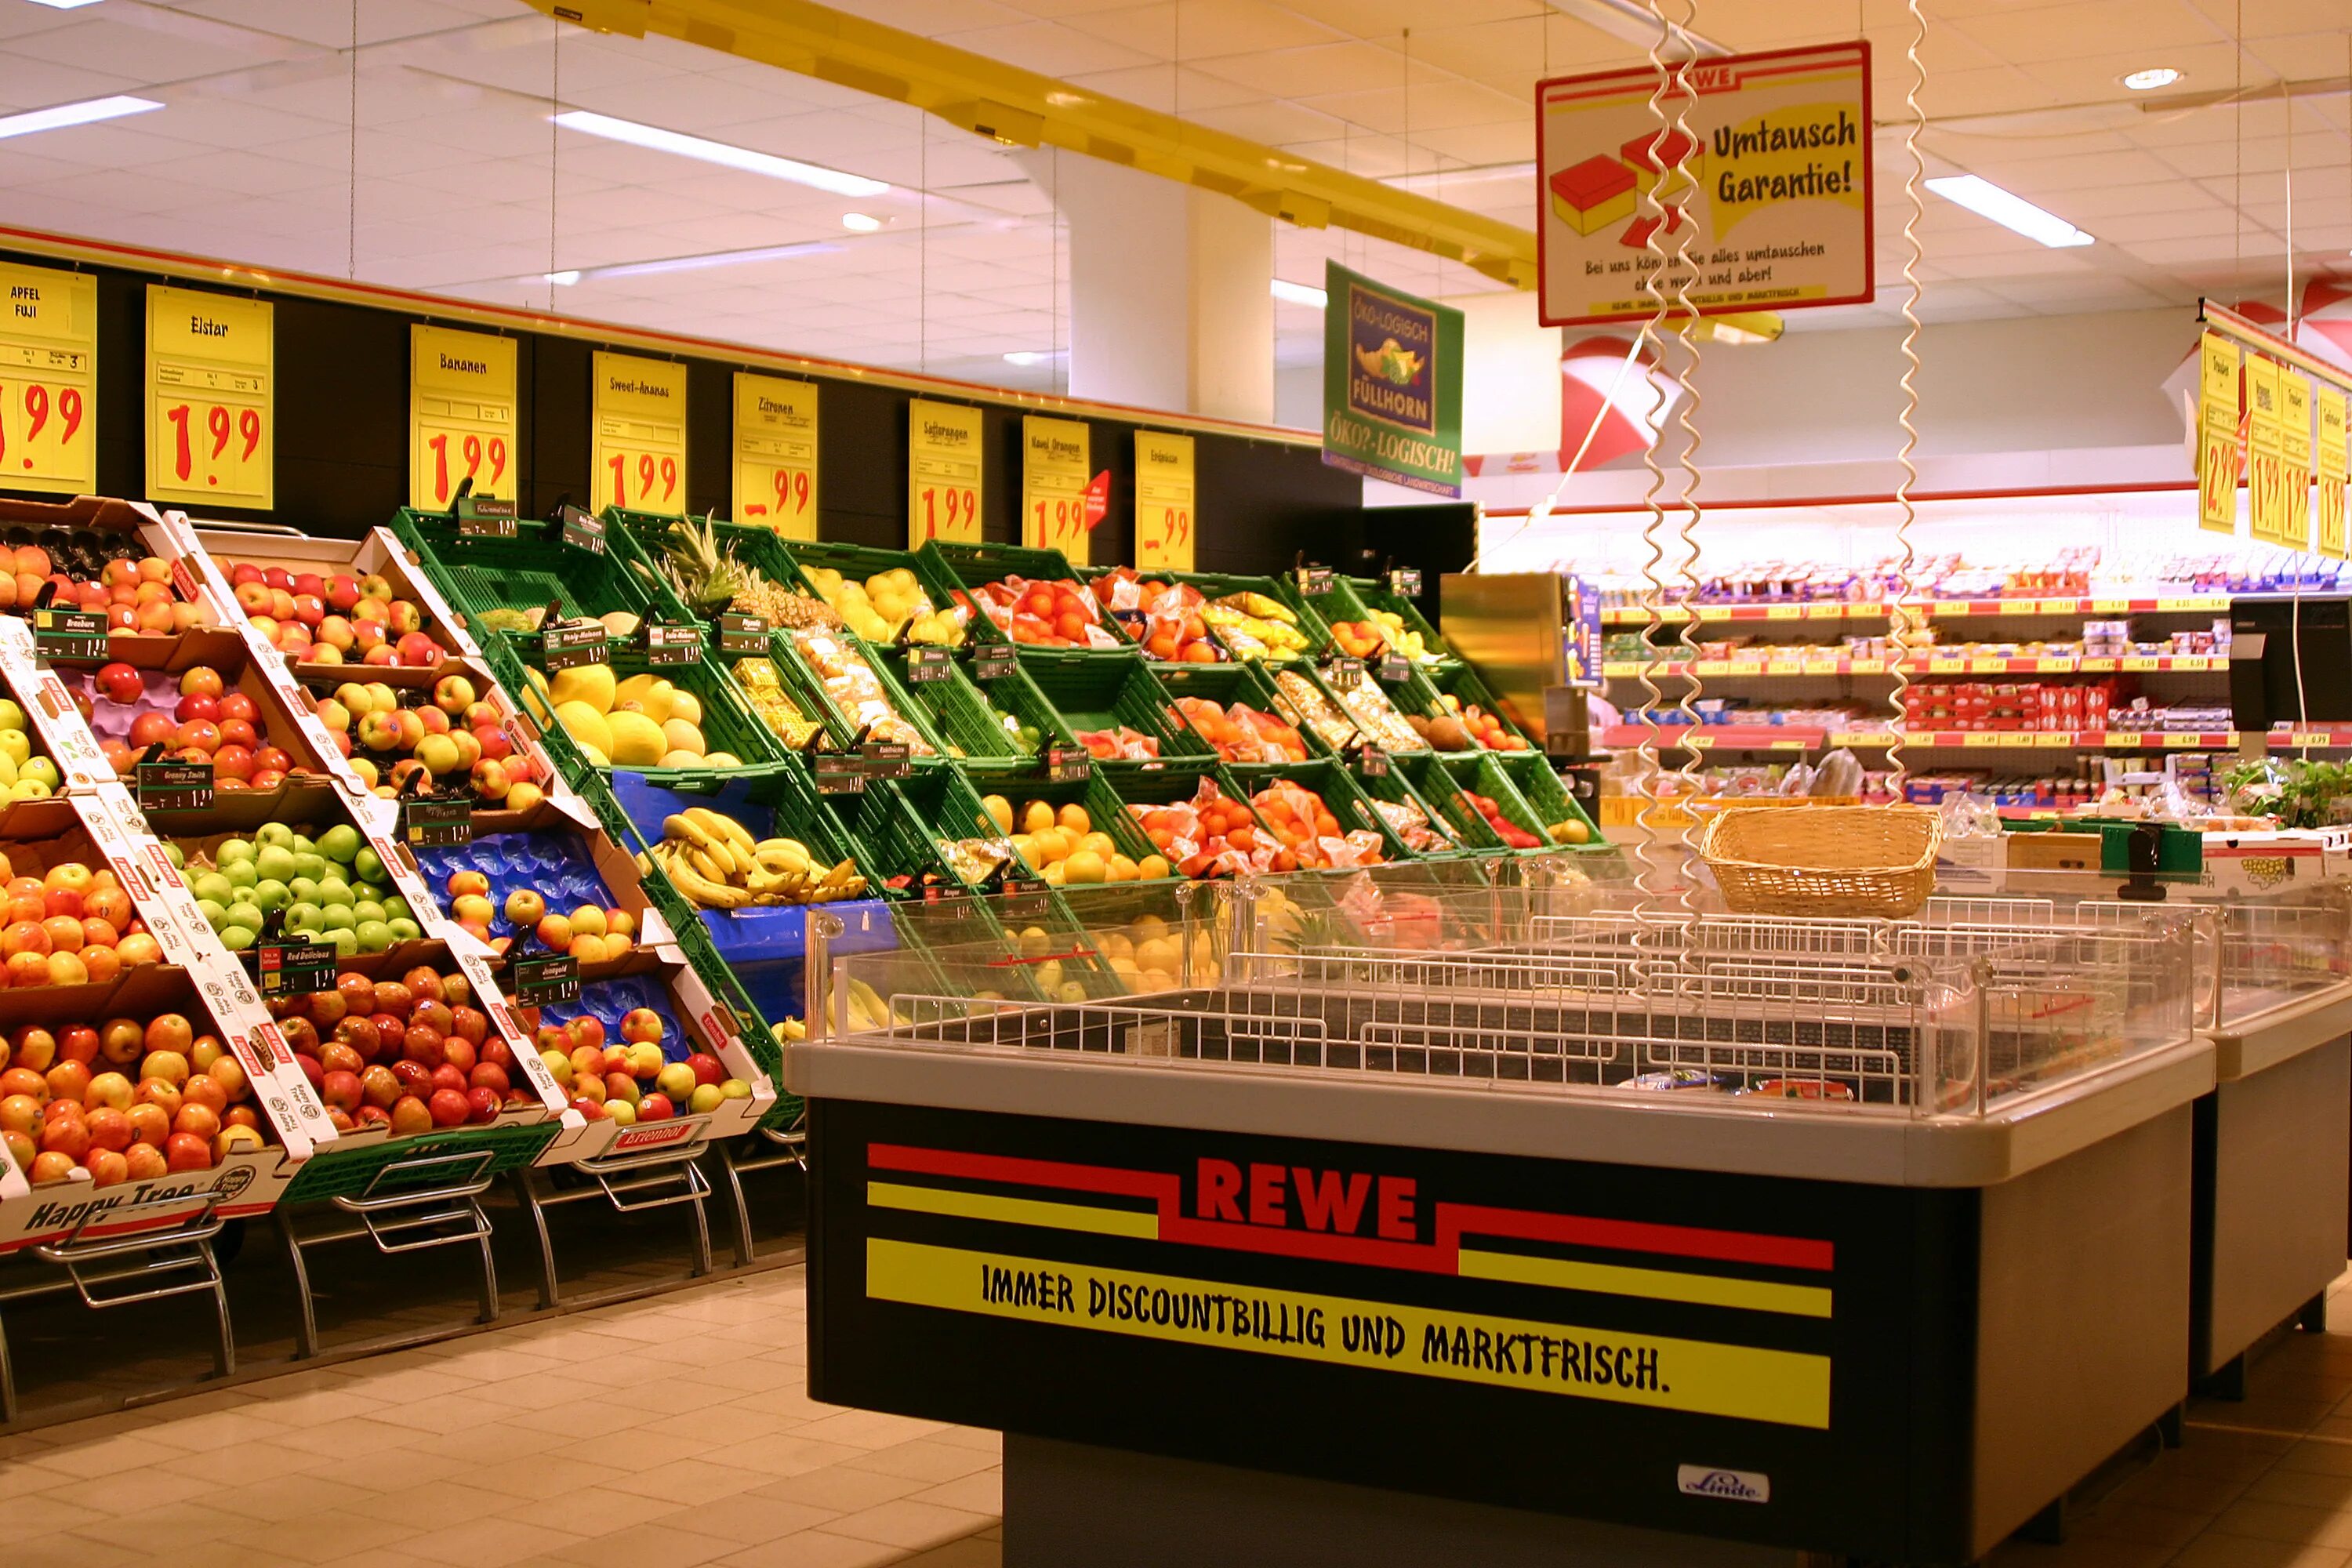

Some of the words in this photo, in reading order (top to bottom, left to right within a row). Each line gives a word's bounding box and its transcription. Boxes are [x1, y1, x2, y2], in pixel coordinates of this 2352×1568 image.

[1714, 111, 1856, 159] Umtausch
[1719, 161, 1853, 203] Garantie!
[1585, 260, 1603, 275] Bei
[1610, 262, 1630, 273] uns
[1711, 249, 1739, 263] alles
[1746, 241, 1824, 262] umtauschen
[1709, 268, 1731, 285] und
[1738, 265, 1772, 282] aber!
[10, 285, 40, 302] APFEL
[15, 303, 36, 318] FUJI
[191, 315, 228, 338] Elstar
[70, 355, 78, 368] 3
[440, 353, 487, 374] Bananen
[609, 376, 670, 398] Sweet-Ananas
[1353, 377, 1428, 421] FÜLLHORN
[758, 396, 793, 415] Zitronen
[0, 384, 82, 469] .99
[167, 405, 260, 485] 1.99
[287, 951, 299, 960] Red
[300, 950, 329, 960] Delicious
[24, 1196, 123, 1231] Happy
[129, 1182, 195, 1212] Tree
[1196, 1157, 1417, 1242] REWE
[981, 1265, 1076, 1315] IMMER
[1087, 1276, 1327, 1350] DISCOUNTBILLIG
[1340, 1315, 1406, 1360] UND
[1421, 1324, 1671, 1394] MARKTFRISCH.
[1686, 1472, 1756, 1497] Linde
